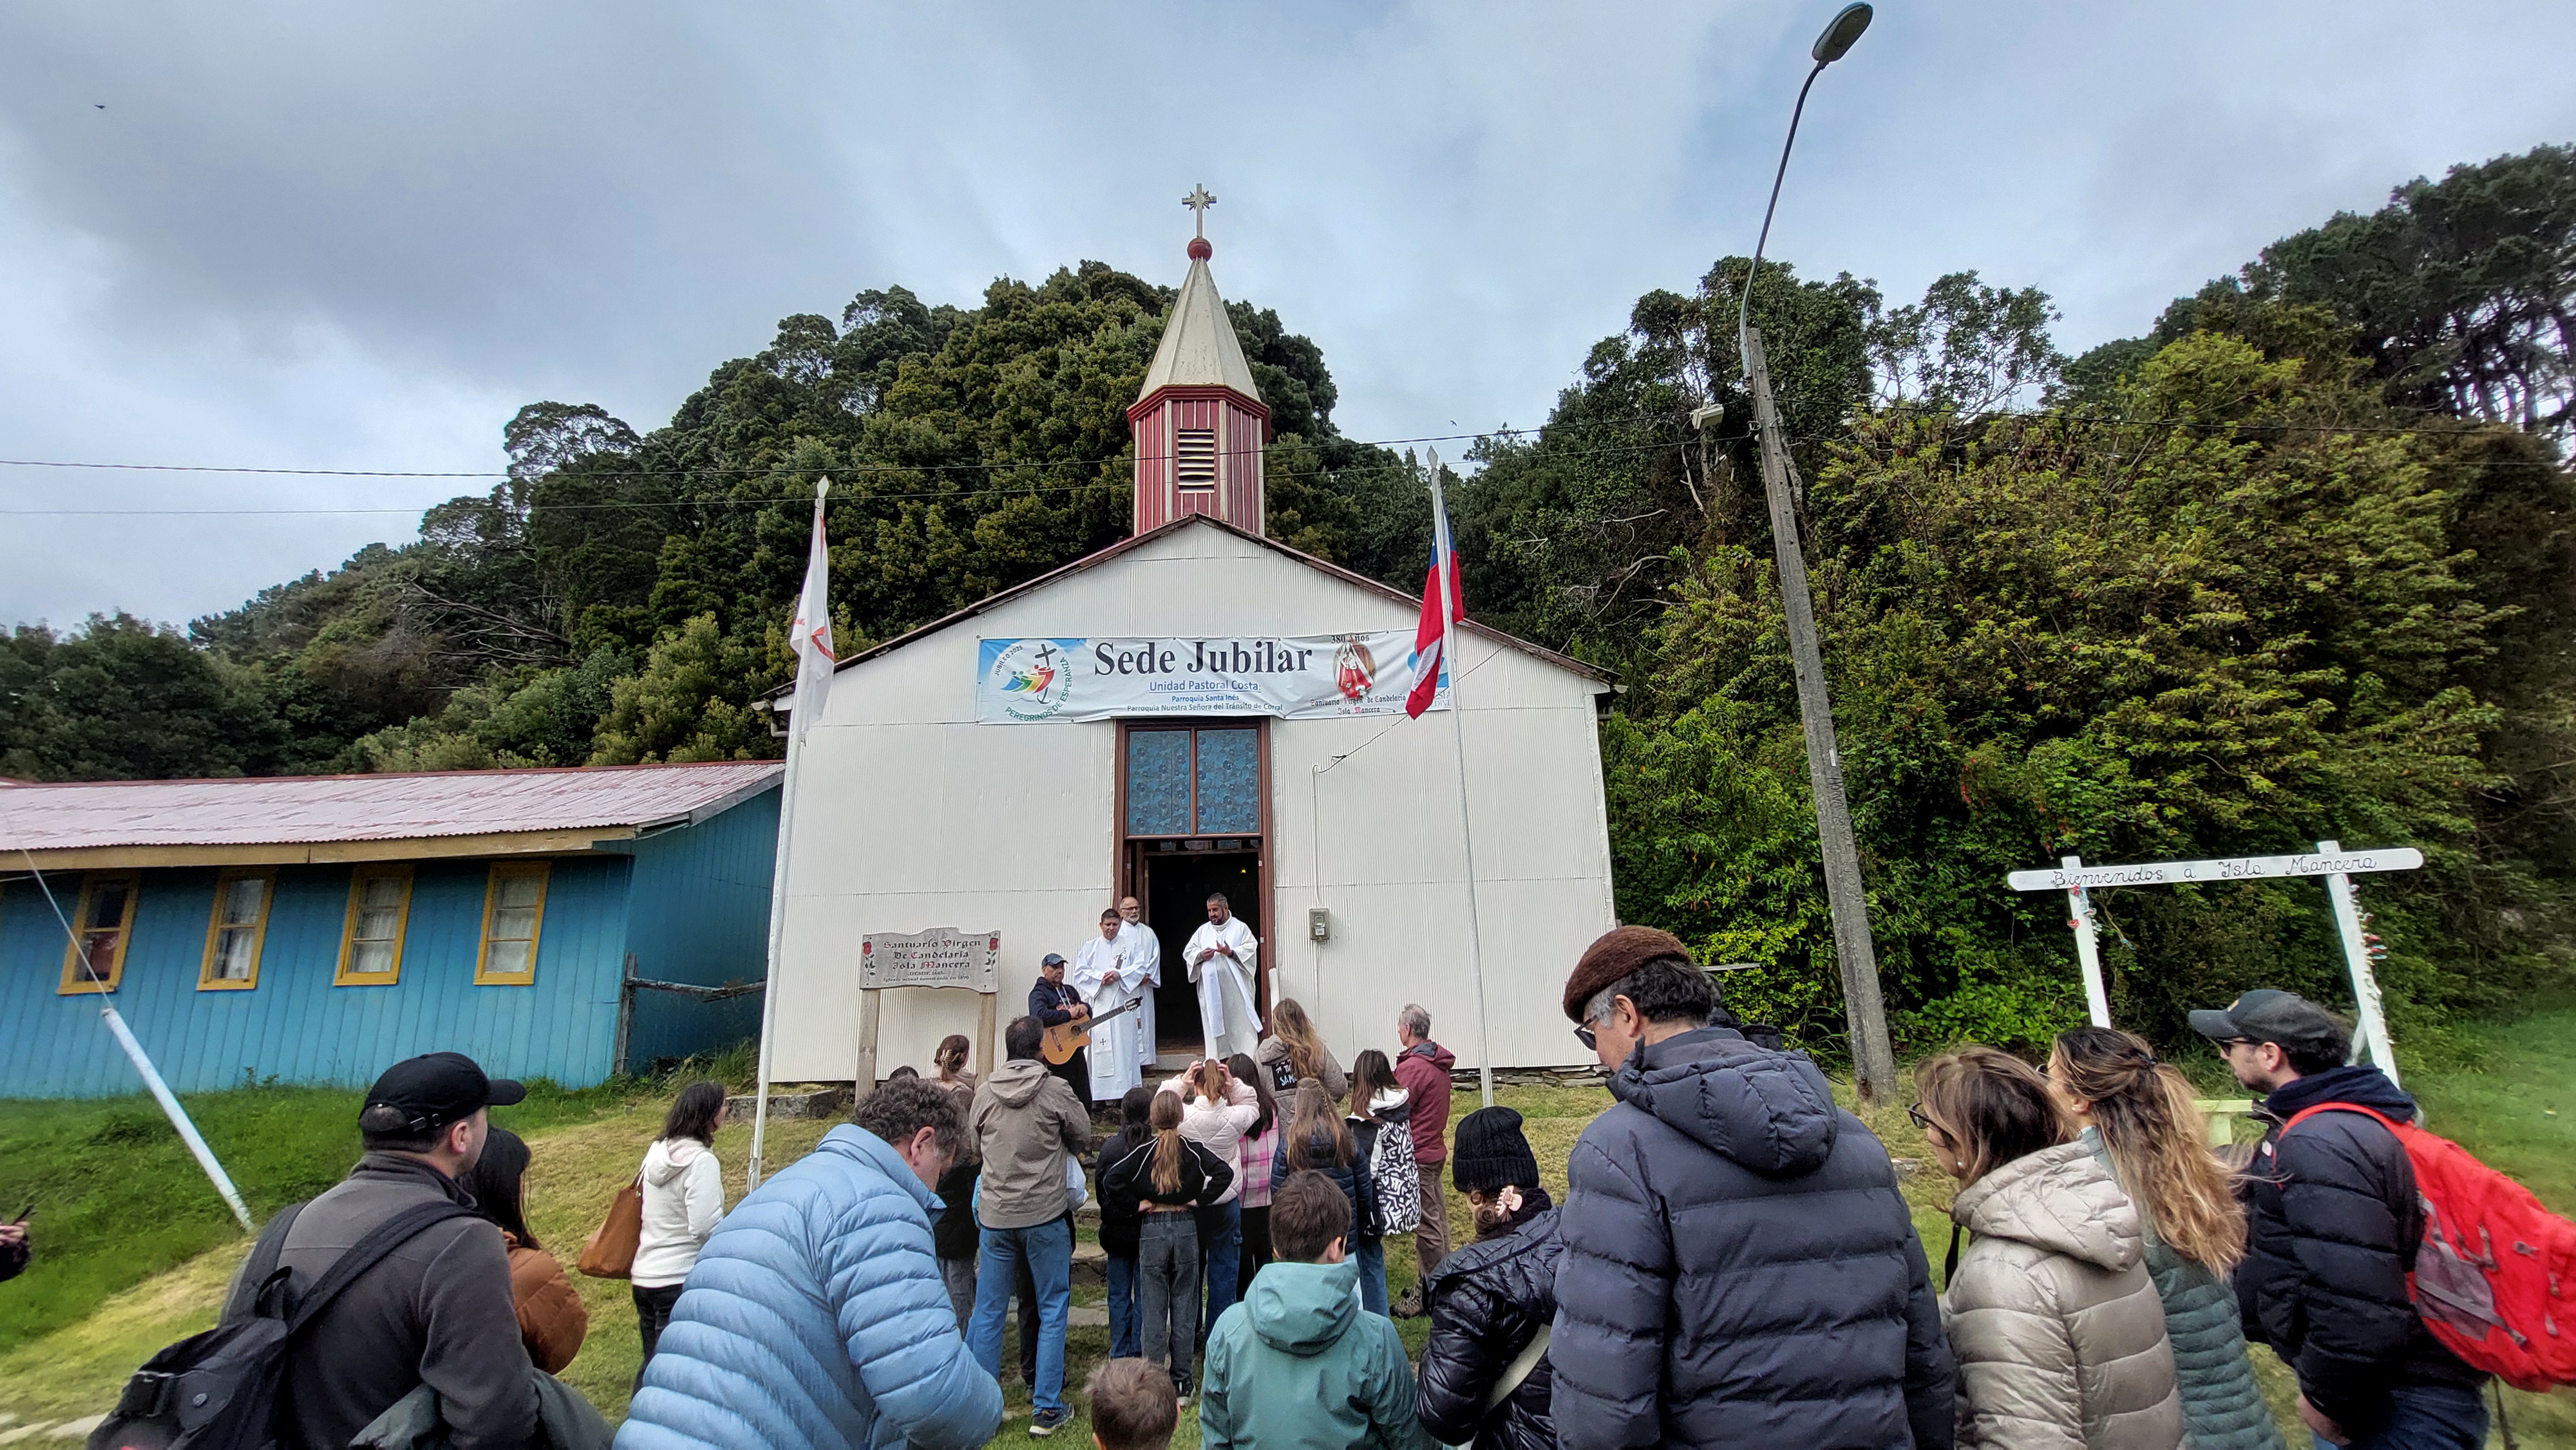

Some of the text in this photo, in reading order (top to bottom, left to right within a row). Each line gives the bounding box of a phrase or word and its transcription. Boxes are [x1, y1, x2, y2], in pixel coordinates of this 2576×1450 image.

[1331, 634, 1345, 643] 380
[994, 645, 1023, 677] JUBILEO 2025
[1095, 641, 1312, 675] Sede Jubilar
[1005, 657, 1072, 722] PEREGRINOS DE ESPERANZA
[1150, 679, 1262, 692] Unidad Pastoral Costa:
[1310, 698, 1340, 706] Santuario
[1344, 697, 1363, 706] Virgen
[1374, 693, 1406, 703] Candelaria
[2050, 867, 2163, 888] Bienvenidos
[2184, 868, 2197, 879] a
[2286, 856, 2377, 874] Mancera
[884, 938, 980, 948] Santuario Virgen
[920, 961, 970, 970] Mancera
[1280, 1074, 1298, 1086] SAM
